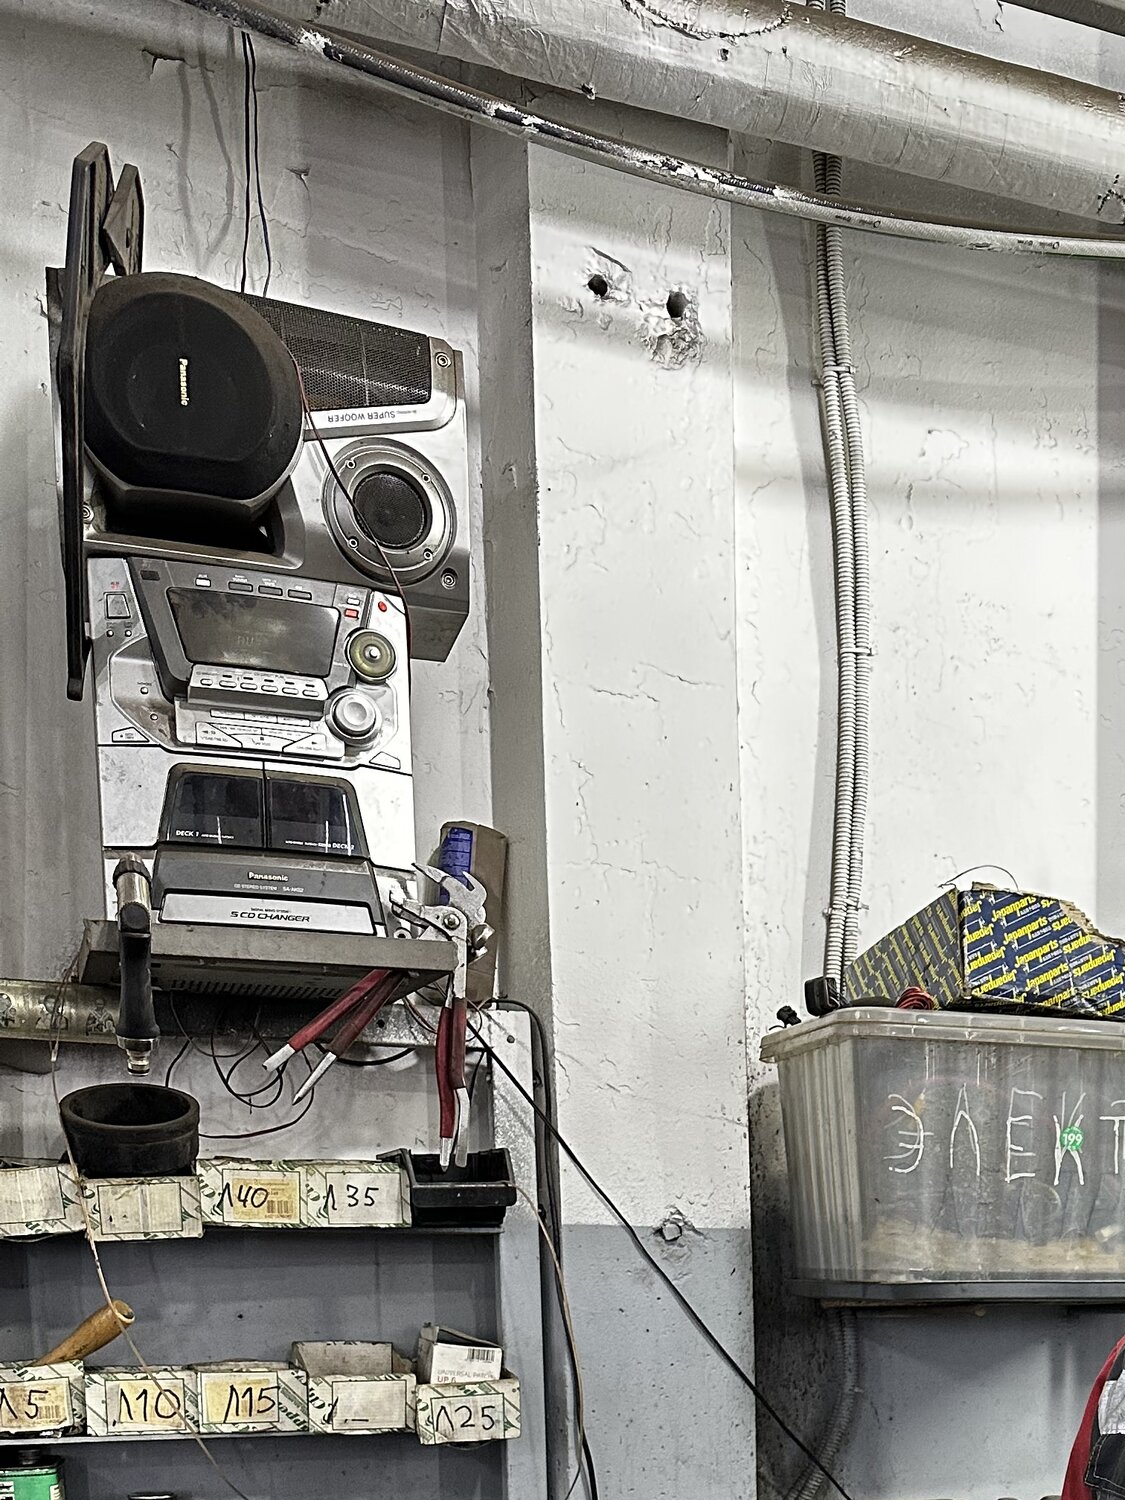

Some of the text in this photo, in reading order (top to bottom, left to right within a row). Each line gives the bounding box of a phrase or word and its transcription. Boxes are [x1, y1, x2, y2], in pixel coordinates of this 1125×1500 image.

[179, 358, 190, 406] Panasonic
[327, 411, 366, 423] WOOFER
[367, 410, 396, 420] SUPER
[175, 829, 194, 838] DECK
[248, 871, 288, 882] Panasonic
[992, 896, 1036, 922] Japanparts
[257, 913, 310, 922] CHANGER
[1003, 916, 1048, 944] Japanparts
[1015, 939, 1058, 968] Japanparts
[1025, 963, 1068, 991] Japanparts
[1062, 1132, 1083, 1146] 199
[437, 1375, 449, 1383] UP
